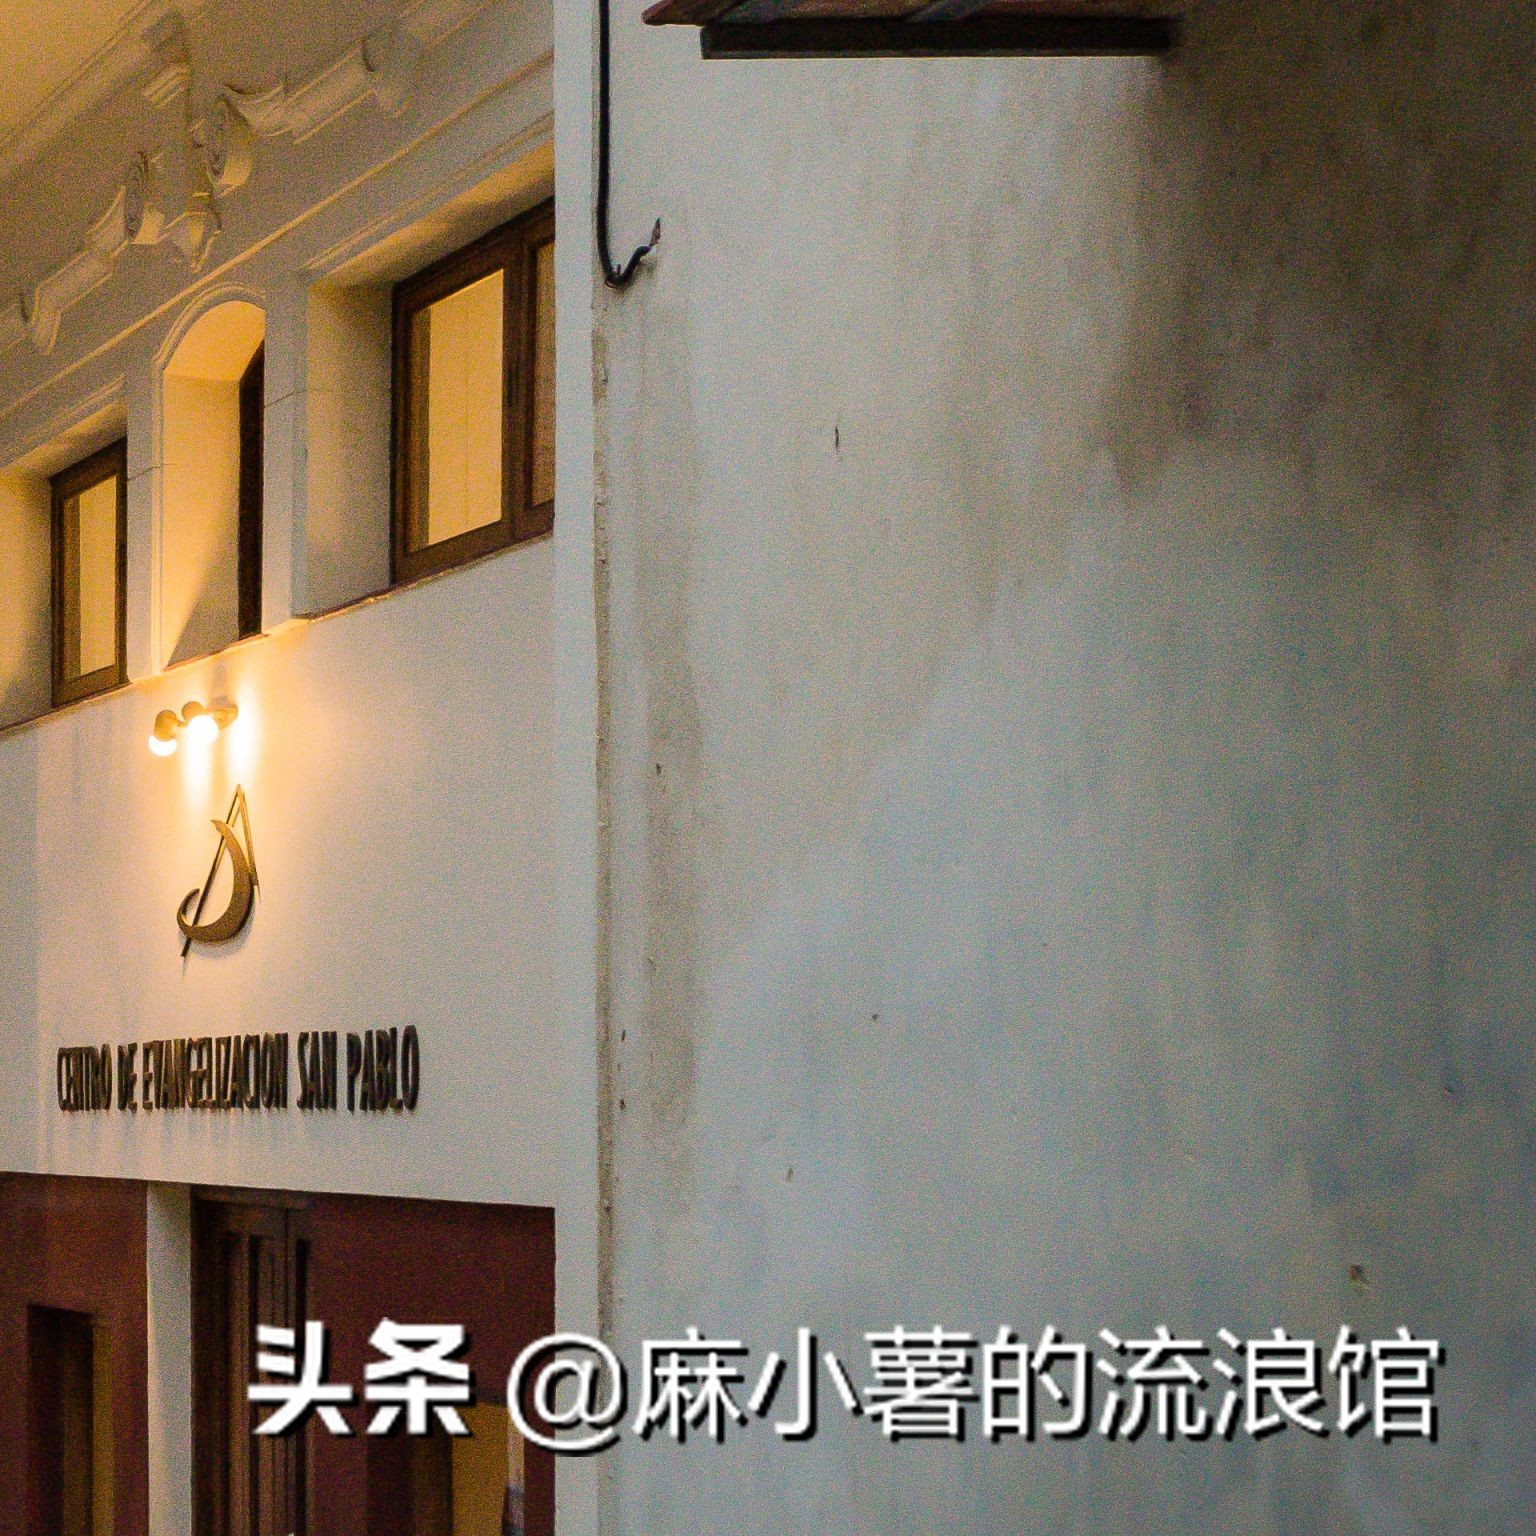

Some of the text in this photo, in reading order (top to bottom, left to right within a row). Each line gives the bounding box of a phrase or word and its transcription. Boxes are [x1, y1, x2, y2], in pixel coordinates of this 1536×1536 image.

[57, 1025, 420, 1112] CENTRO DE EVANGELIZACION SAN PABLO
